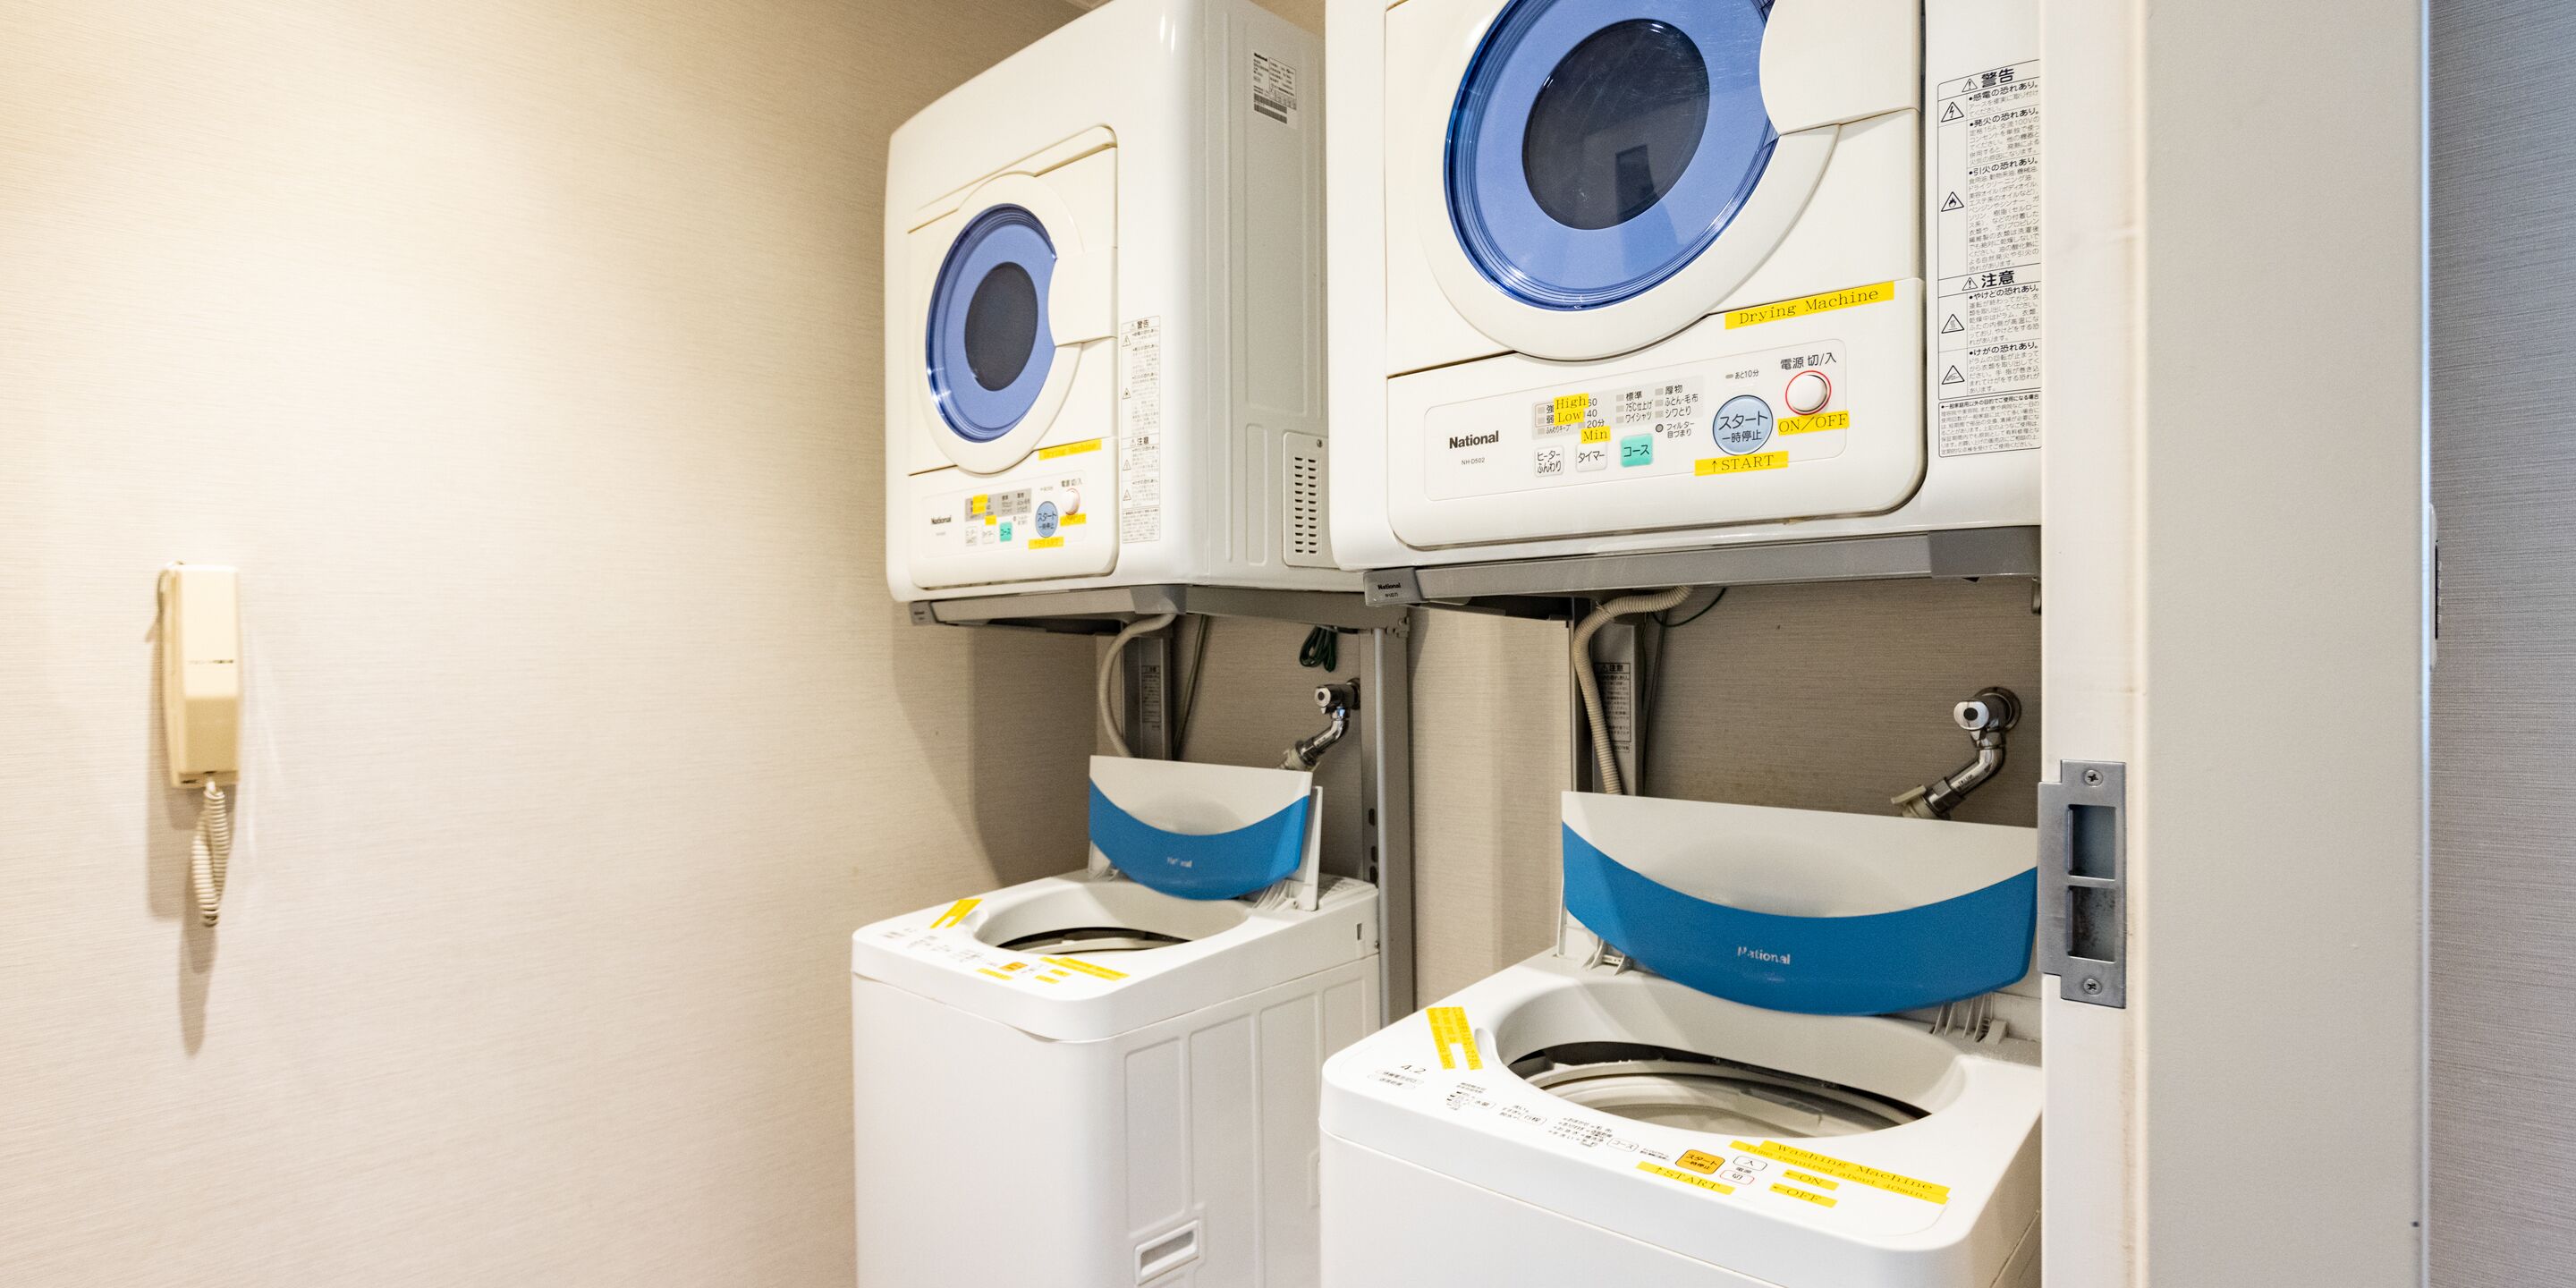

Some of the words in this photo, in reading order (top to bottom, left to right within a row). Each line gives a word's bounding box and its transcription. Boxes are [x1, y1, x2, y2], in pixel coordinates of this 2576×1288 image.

[1981, 68, 2015, 89] 警告
[1973, 107, 2038, 127] 発火の恐れあり。
[1973, 157, 2038, 175] 引火の恐れあり。
[1981, 270, 2015, 288] 注意
[1973, 284, 2038, 300] やけどの恐れあり。
[1739, 302, 1797, 325] Drying
[1805, 289, 1879, 312] Machine
[1973, 342, 2038, 355] けがの恐れあり。
[1780, 356, 1804, 370] 電源
[1807, 352, 1837, 367] 切/入
[1734, 369, 1759, 379] あと10分
[1626, 390, 1642, 401] 標準
[1665, 385, 1683, 395] 厚物
[1555, 395, 1587, 410] High
[1556, 411, 1581, 424] Low
[1587, 409, 1597, 418] 40
[1625, 411, 1652, 424] ワイシャツ
[1665, 406, 1692, 419] シワとり
[1587, 419, 1606, 429] 20分
[1666, 420, 1695, 431] フィルター
[1718, 411, 1768, 430] スタート
[1778, 412, 1849, 433] ON/OFF
[1449, 430, 1499, 449] National
[1583, 428, 1608, 442] Min
[1667, 428, 1692, 439] 目づまり
[1722, 429, 1762, 443] 一時停止
[1537, 450, 1561, 462] ヒーター
[1578, 451, 1605, 463] タイマー
[1623, 445, 1650, 458] コース
[1537, 461, 1562, 474] ふんわり
[1721, 454, 1775, 471] START
[1377, 582, 1402, 590] National
[1778, 1145, 1849, 1168] Washing
[1858, 1165, 1933, 1190] Machine
[1664, 1171, 1721, 1190] START
[1799, 1174, 1823, 1185] ON
[1787, 1189, 1822, 1202] OFF
